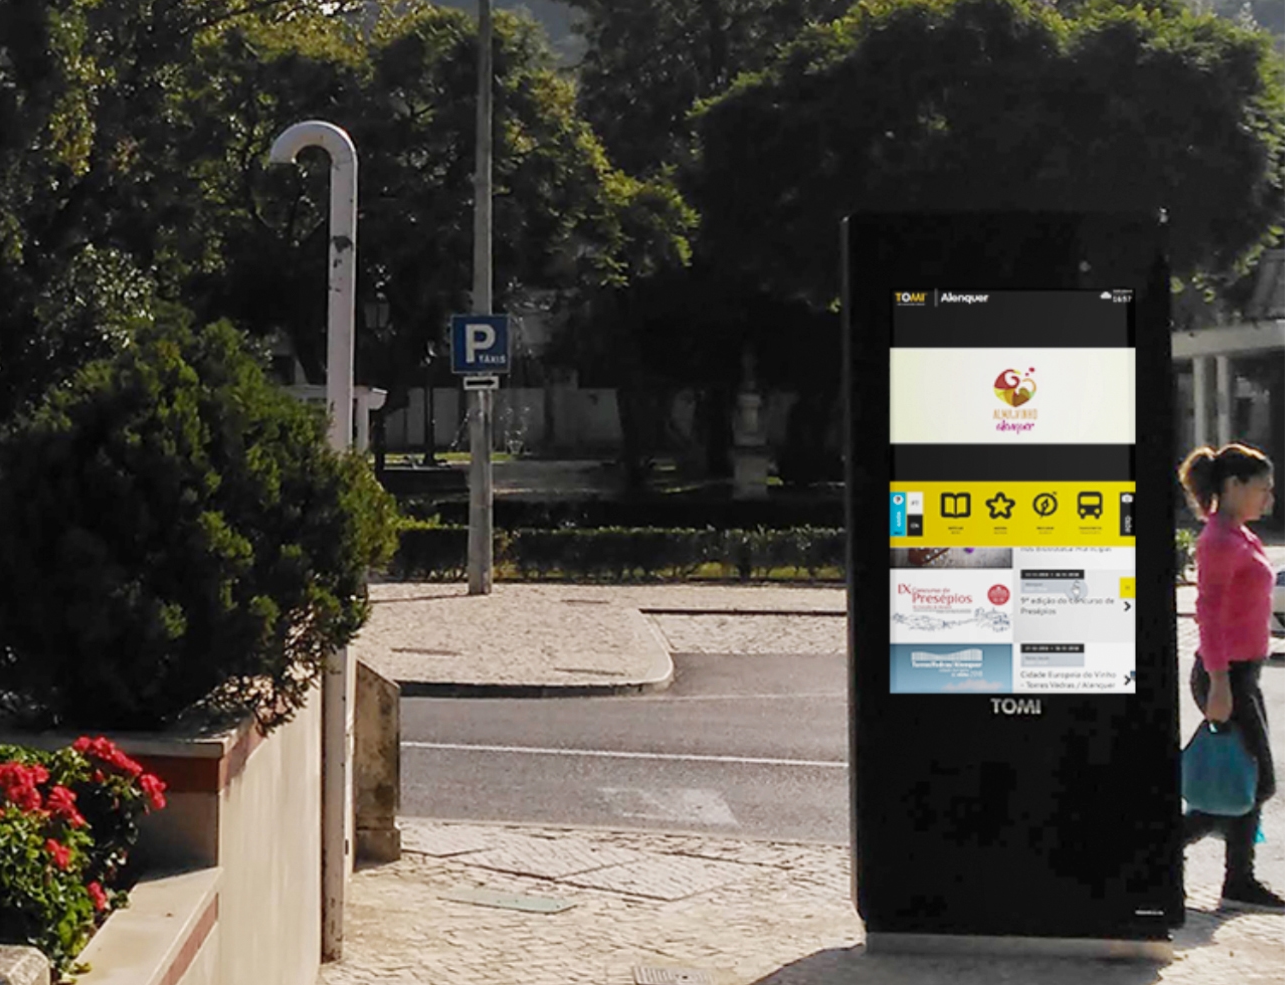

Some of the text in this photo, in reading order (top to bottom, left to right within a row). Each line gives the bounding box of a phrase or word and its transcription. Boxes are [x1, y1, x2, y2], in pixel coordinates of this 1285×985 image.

[895, 292, 989, 305] TOMI Alenquer
[465, 324, 496, 364] P
[898, 583, 912, 595] IX
[912, 593, 973, 606] Presépios
[1020, 671, 1046, 679] Cidade
[1083, 671, 1093, 679] do
[1094, 671, 1117, 679] Vinho
[1026, 681, 1049, 689] Torres
[1082, 681, 1116, 691] Alenquer
[991, 698, 1042, 715] TOMI
